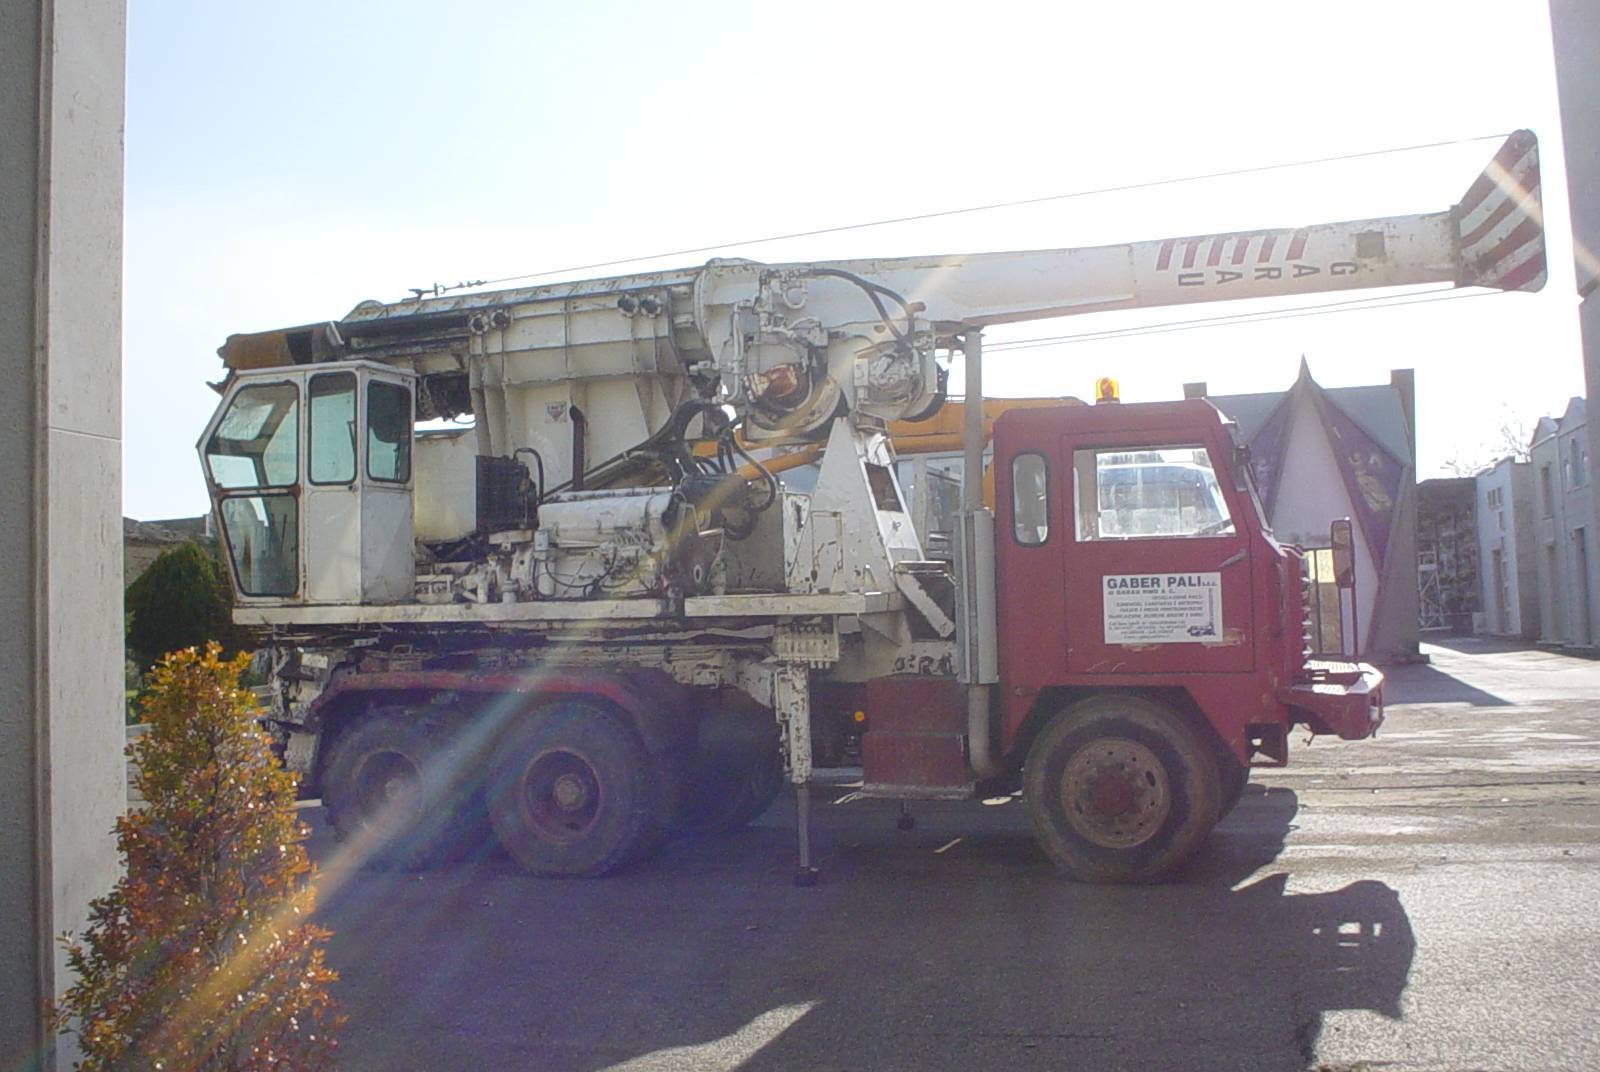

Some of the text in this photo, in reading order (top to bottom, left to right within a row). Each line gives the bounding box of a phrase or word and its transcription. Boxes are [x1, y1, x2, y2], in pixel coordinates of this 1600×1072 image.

[1177, 261, 1358, 287] GARAU
[1107, 577, 1161, 589] GABER
[1167, 576, 1201, 587] PALI
